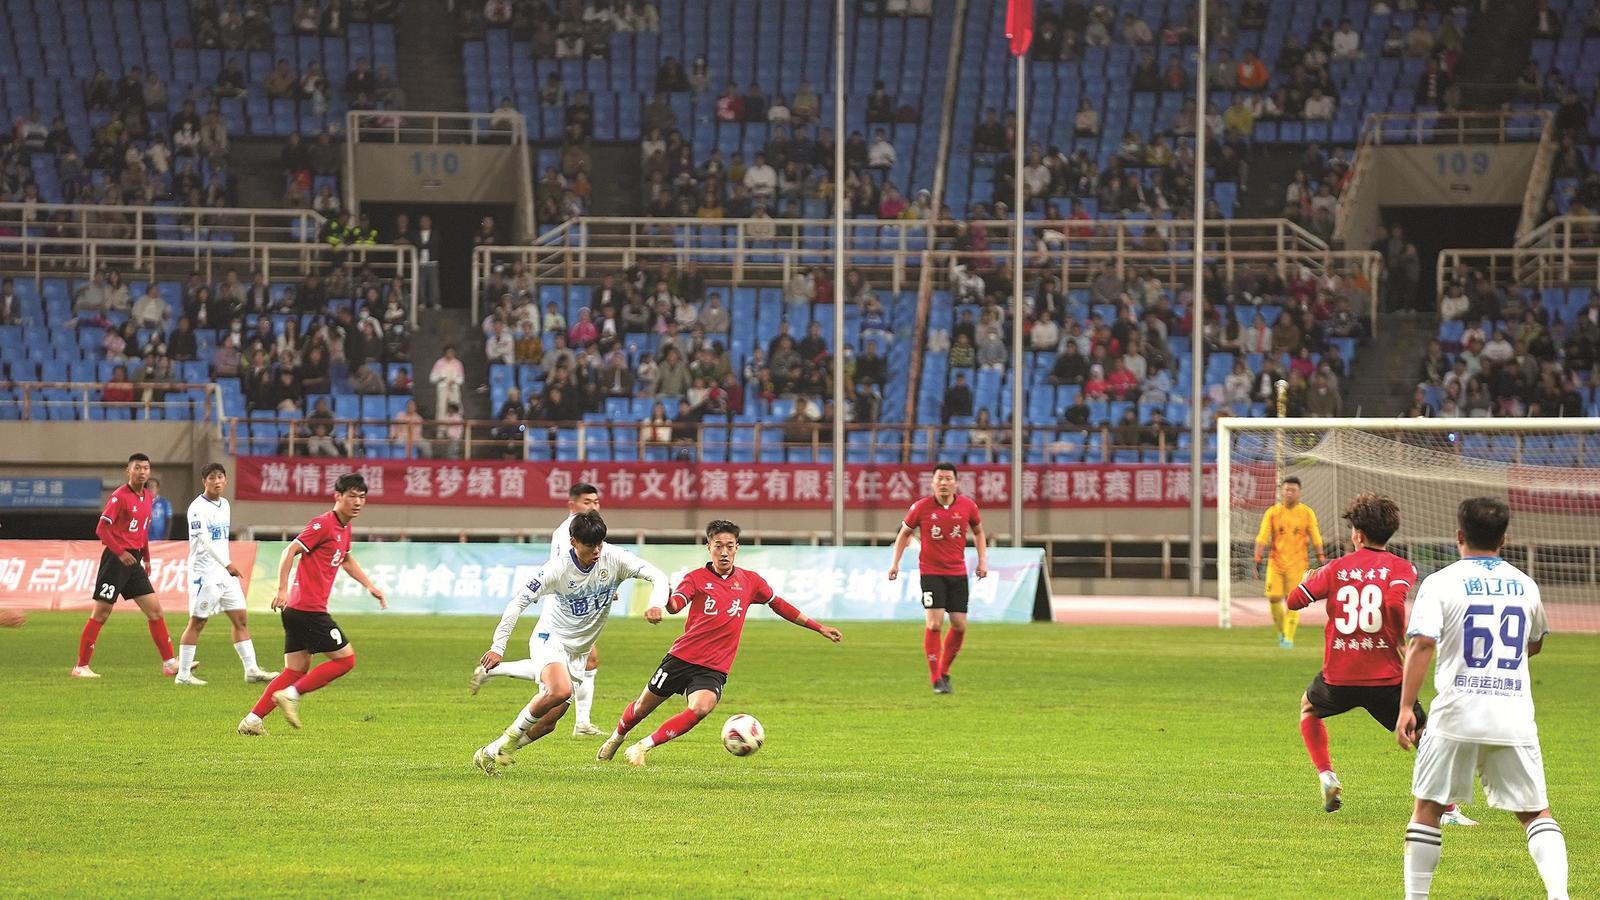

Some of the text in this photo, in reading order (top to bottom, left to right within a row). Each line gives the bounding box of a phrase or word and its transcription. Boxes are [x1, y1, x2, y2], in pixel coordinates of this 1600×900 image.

[410, 152, 461, 176] 110
[1434, 152, 1489, 176] 109
[403, 465, 528, 498] 逐梦绿茵
[931, 524, 964, 539] 包头
[99, 583, 116, 599] 23
[1462, 577, 1525, 596] 通辽市
[568, 589, 613, 617] 通辽
[703, 595, 744, 619] 包头
[1334, 583, 1383, 635] 38
[329, 627, 343, 646] 9
[1463, 604, 1526, 670] 69
[650, 668, 669, 689] 31
